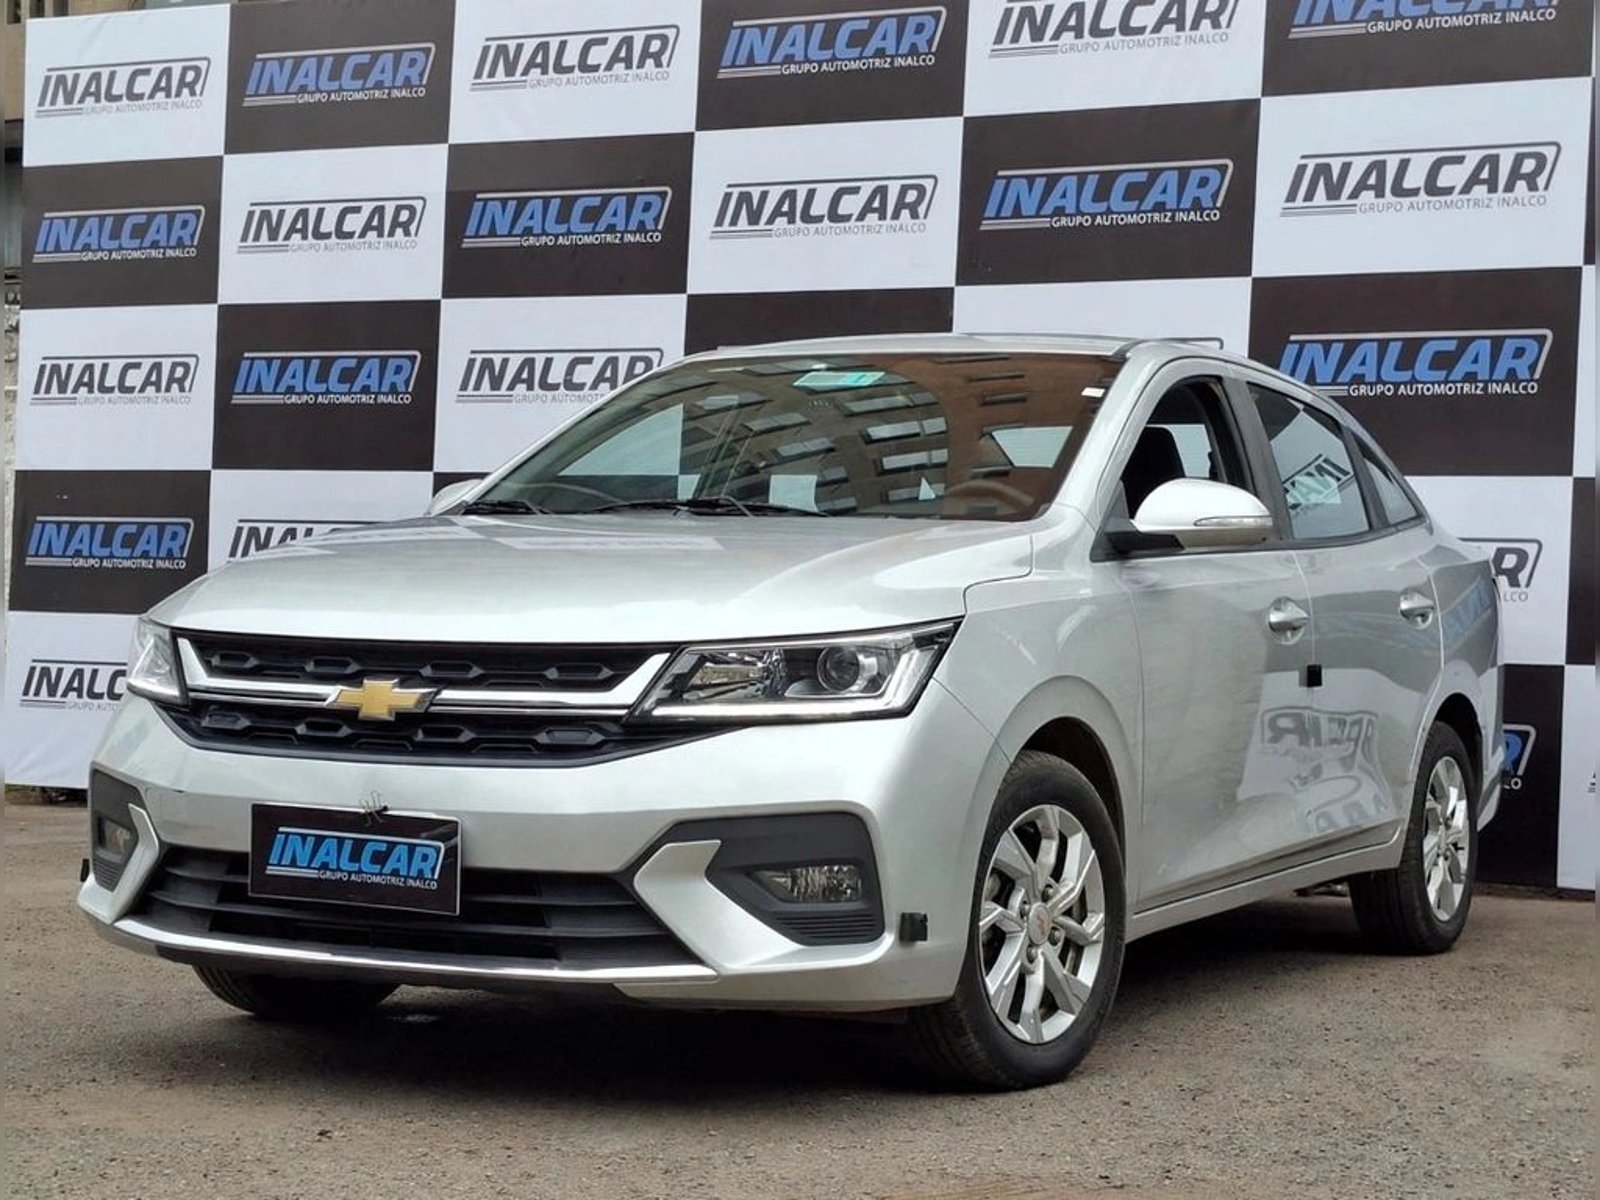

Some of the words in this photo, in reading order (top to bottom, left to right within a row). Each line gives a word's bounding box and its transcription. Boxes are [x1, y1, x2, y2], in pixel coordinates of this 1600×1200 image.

[993, 0, 1230, 45] INALCAR
[1368, 20, 1412, 33] GRUPO
[1416, 13, 1502, 29] AUTOMOTRIZ
[1506, 9, 1556, 24] INALCO
[473, 33, 670, 79] INALCAR
[720, 15, 936, 66] INALCAR
[1060, 42, 1100, 54] GRUPO
[1104, 36, 1180, 50] AUTOMOTRIZ
[1184, 33, 1228, 44] INALCO
[246, 51, 426, 95] INALCAR
[529, 78, 562, 88] GRUPO
[564, 74, 629, 86] AUTOMOTRIZ
[632, 71, 670, 82] INALCO
[782, 64, 818, 74] GRUPO
[820, 58, 890, 72] AUTOMOTRIZ
[894, 55, 935, 66] INALCO
[38, 65, 202, 107] INALCAR
[298, 93, 327, 102] GRUPO
[330, 89, 388, 101] AUTOMOTRIZ
[391, 87, 426, 98] INALCO
[984, 168, 1221, 218] INALCAR
[1284, 151, 1548, 203] INALCAR
[465, 194, 662, 236] INALCAR
[714, 184, 926, 228] INALCAR
[1051, 216, 1092, 228] GRUPO
[1094, 212, 1172, 226] AUTOMOTRIZ
[1175, 209, 1220, 222] INALCO
[1359, 202, 1402, 214] GRUPO
[1408, 198, 1492, 212] AUTOMOTRIZ
[1497, 195, 1547, 208] INALCO
[35, 212, 197, 252] INALCAR
[240, 204, 417, 242] INALCAR
[522, 236, 554, 246] GRUPO
[557, 234, 620, 246] AUTOMOTRIZ
[624, 232, 662, 242] INALCO
[774, 227, 810, 238] GRUPO
[812, 224, 883, 236] AUTOMOTRIZ
[886, 223, 926, 234] INALCO
[81, 252, 108, 261] GRUPO
[111, 249, 163, 260] AUTOMOTRIZ
[166, 247, 196, 257] INALCO
[290, 242, 320, 253] GRUPO
[323, 241, 380, 252] AUTOMOTRIZ
[383, 240, 417, 250] INALCO
[234, 358, 412, 392] INALCAR
[1280, 338, 1539, 382] INALCAR
[34, 361, 192, 394] INALCAR
[1350, 384, 1394, 396] GRUPO
[1398, 383, 1484, 395] AUTOMOTRIZ
[1488, 382, 1538, 394] INALCO
[284, 395, 314, 404] GRUPO
[317, 394, 376, 404] AUTOMOTRIZ
[378, 394, 412, 404] INALCO
[28, 523, 186, 557] INALCAR
[72, 558, 100, 568] GRUPO
[102, 558, 153, 568] AUTOMOTRIZ
[156, 560, 186, 570] INALCO
[22, 666, 126, 700] INALC
[268, 834, 438, 878] INALCAR
[319, 870, 349, 881] GRUPO
[350, 872, 404, 886] AUTOMOTRIZ
[407, 876, 437, 890] INALCO
